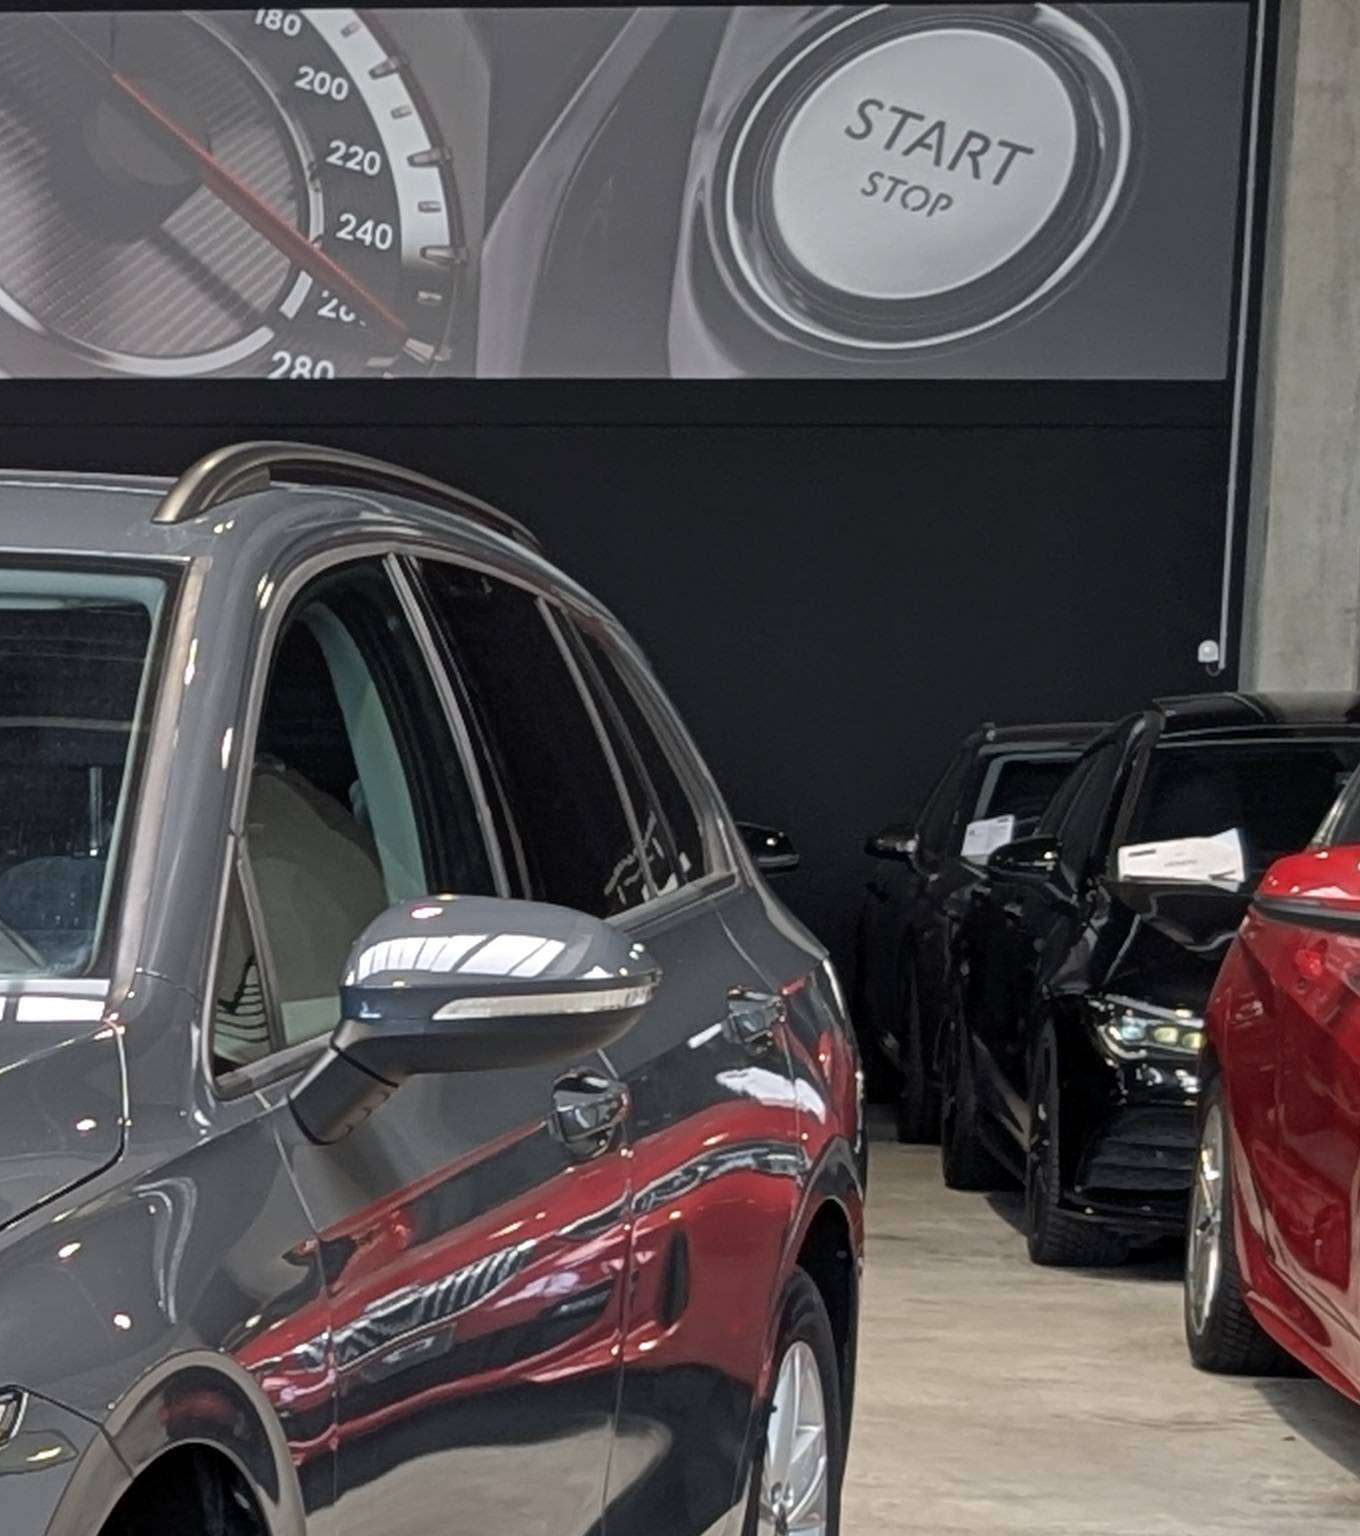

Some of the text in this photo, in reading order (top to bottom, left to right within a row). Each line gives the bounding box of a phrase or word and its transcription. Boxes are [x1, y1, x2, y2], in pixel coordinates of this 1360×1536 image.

[254, 9, 301, 36] 180
[294, 66, 348, 101] 200
[325, 140, 381, 178] 220
[844, 98, 1034, 186] START
[860, 171, 954, 218] STOP
[335, 213, 394, 251] 240
[268, 351, 335, 379] 280
